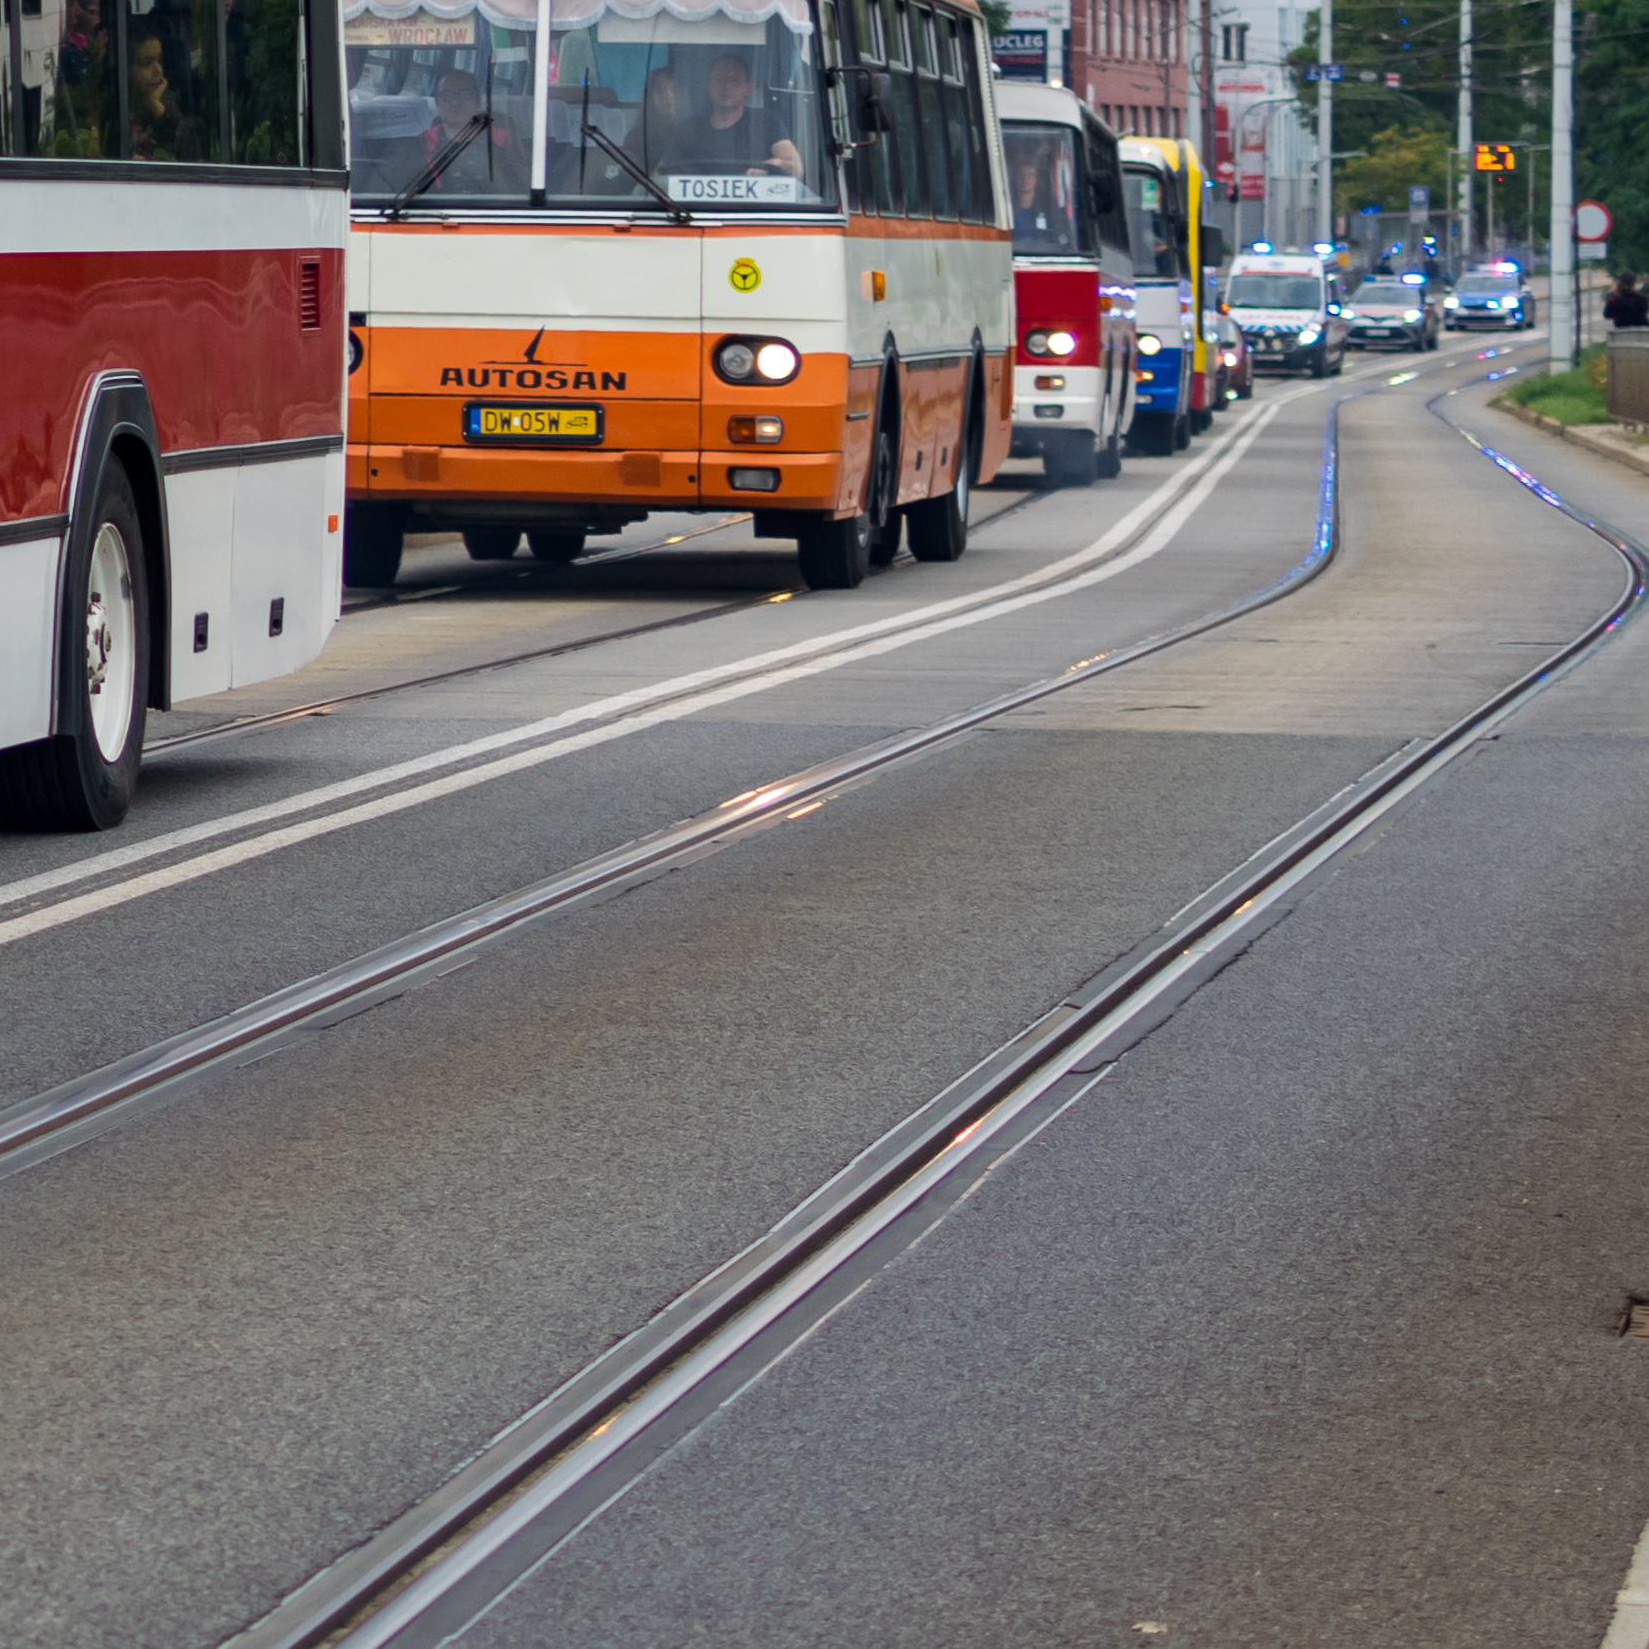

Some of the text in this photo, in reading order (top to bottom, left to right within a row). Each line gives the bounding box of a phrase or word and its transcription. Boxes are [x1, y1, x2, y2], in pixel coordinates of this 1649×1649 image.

[389, 28, 468, 44] WROCŁAW
[679, 179, 758, 200] TOSIEK
[440, 367, 626, 391] AUTOSAN
[485, 411, 512, 432] DW
